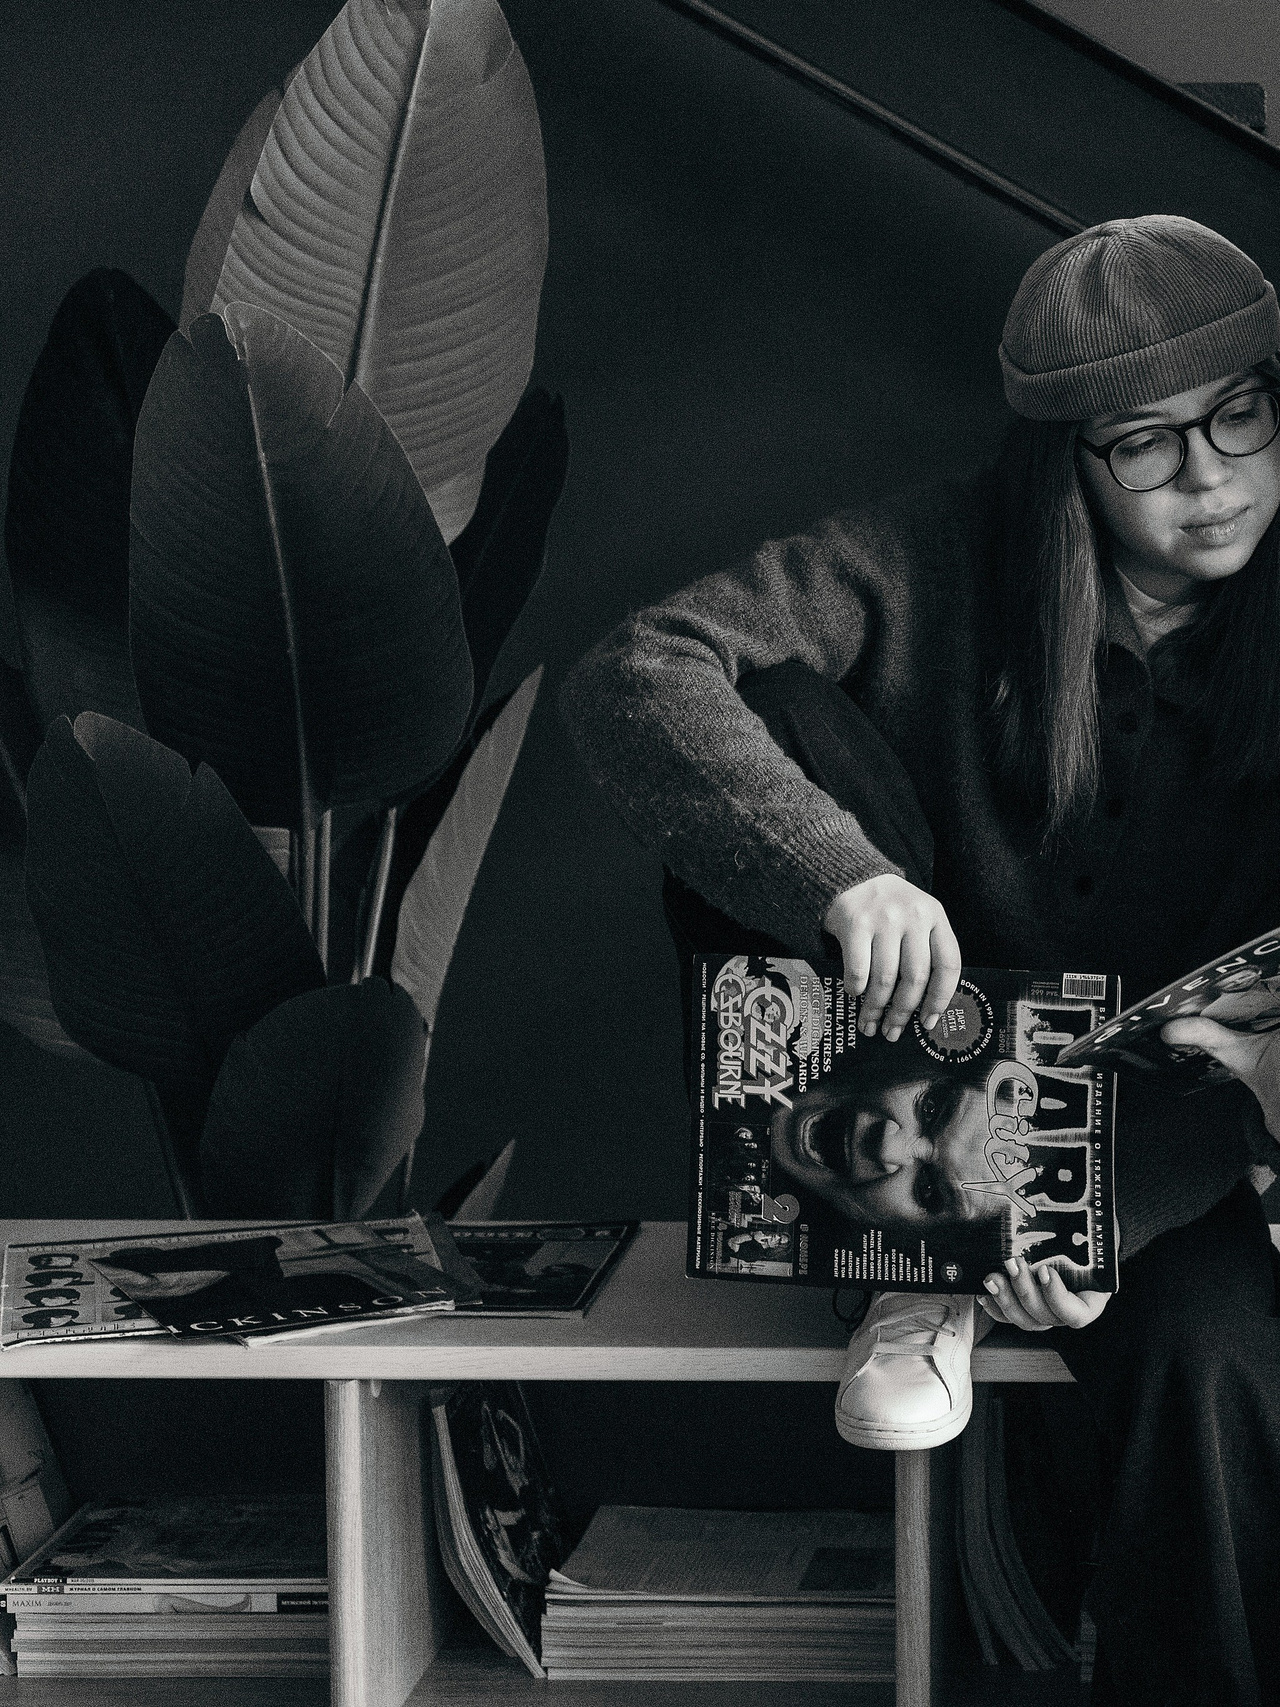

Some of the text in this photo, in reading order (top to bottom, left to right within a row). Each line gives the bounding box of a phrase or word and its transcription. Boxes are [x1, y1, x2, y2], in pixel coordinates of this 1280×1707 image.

[799, 975, 808, 1022] DEMONS
[835, 978, 845, 1055] ANNIHILATOR
[960, 979, 994, 1020] BORN IN 1991
[711, 968, 747, 1111] OSBOURNE
[811, 976, 820, 1080] BRUCE DICKINSON
[823, 977, 832, 1073] DARK FORTRESS
[848, 995, 857, 1049] EMATORY
[913, 1020, 922, 1038] 1991
[946, 1009, 957, 1032] СИТИ
[954, 1008, 967, 1031] ДАРК
[742, 974, 796, 1111] OZZY
[918, 1038, 928, 1048] IN
[925, 1046, 945, 1062] BORN
[956, 1027, 993, 1063] BORN IN 1991
[998, 1028, 1006, 1054] 36900
[798, 1039, 808, 1093] WIZARDS
[1094, 1072, 1105, 1269] ИЗДАНИЕ О ТЯЖЕЛОЙ МУЗЫКЕ
[761, 1192, 800, 1225] 2
[946, 1264, 958, 1281] 16+
